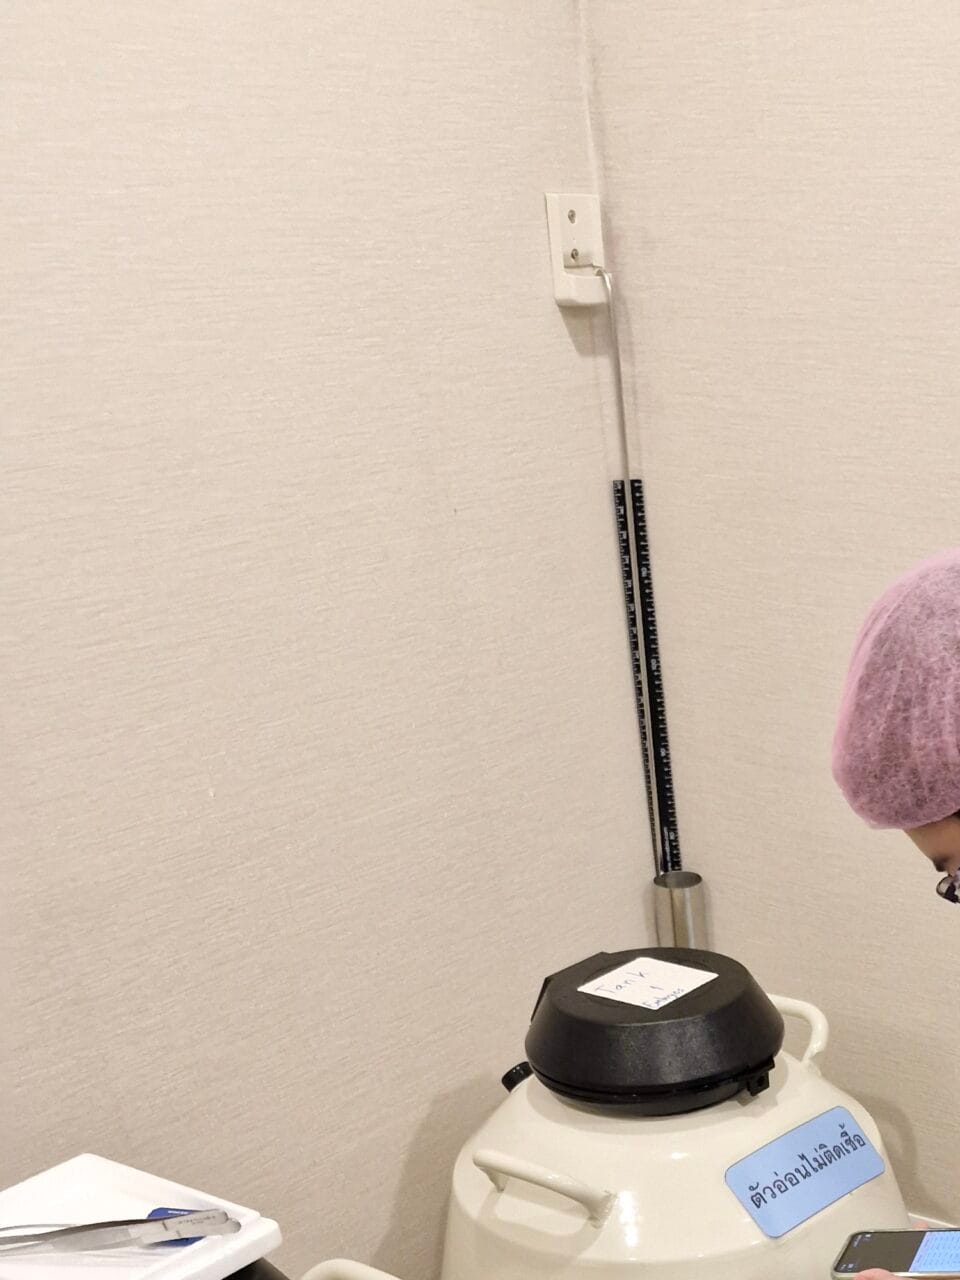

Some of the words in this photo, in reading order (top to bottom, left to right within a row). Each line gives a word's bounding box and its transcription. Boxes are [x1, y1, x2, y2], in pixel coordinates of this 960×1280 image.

[748, 1122, 866, 1209] ตัวอ่อนไม่ติดเชื้อ
